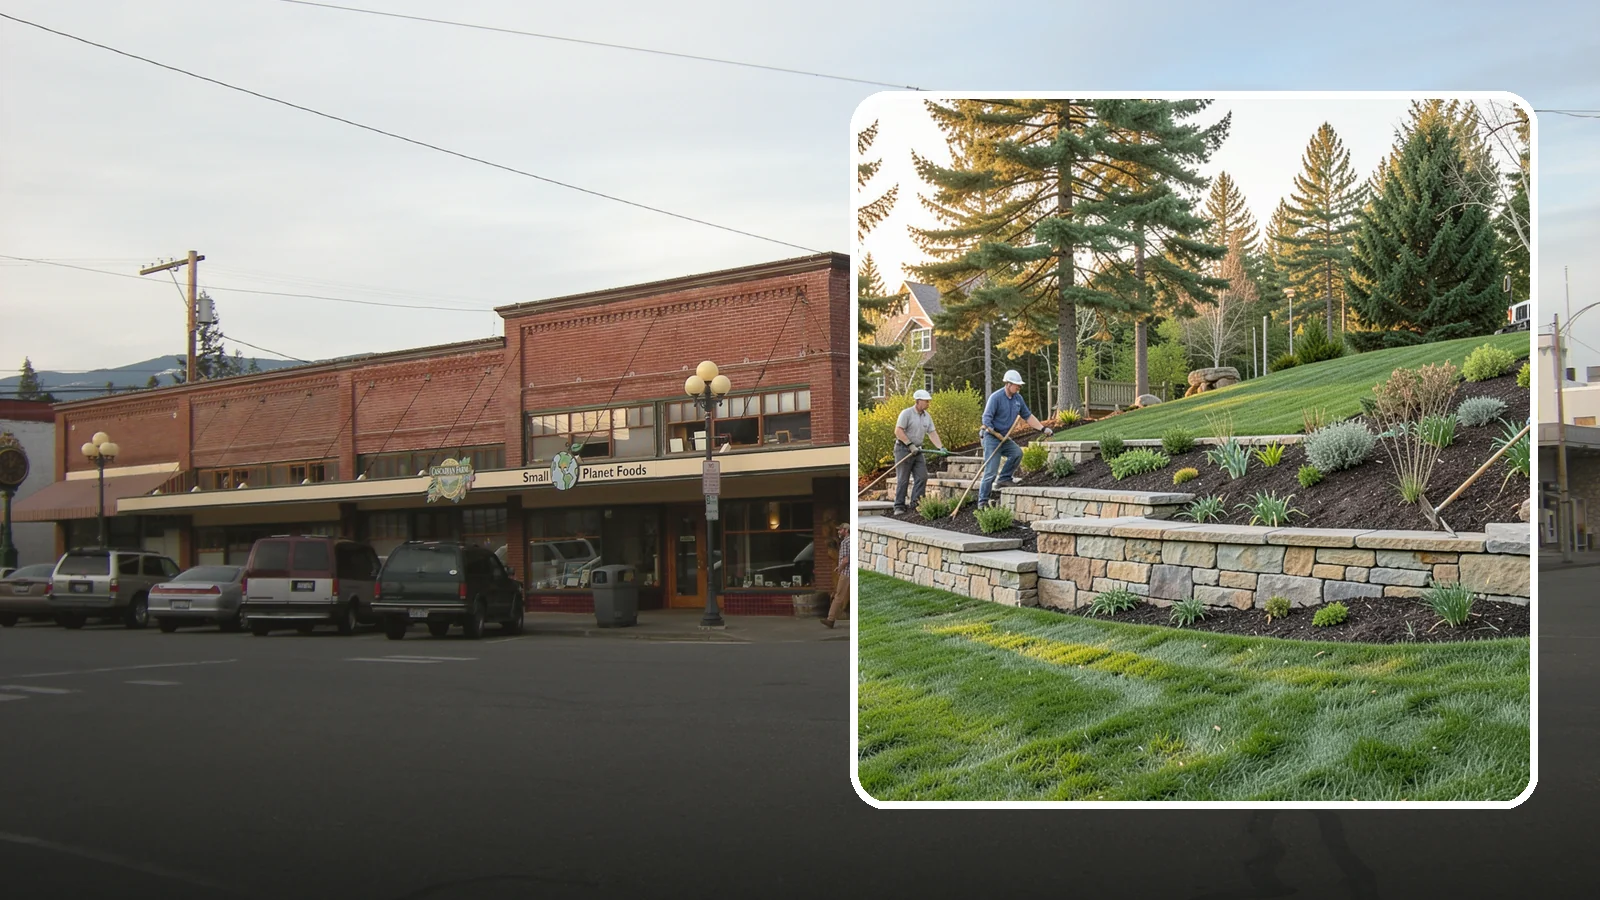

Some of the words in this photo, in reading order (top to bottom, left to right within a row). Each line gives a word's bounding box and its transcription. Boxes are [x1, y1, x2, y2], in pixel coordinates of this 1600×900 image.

[523, 471, 549, 483] Small
[582, 467, 614, 479] Planet
[616, 464, 647, 477] Foods
